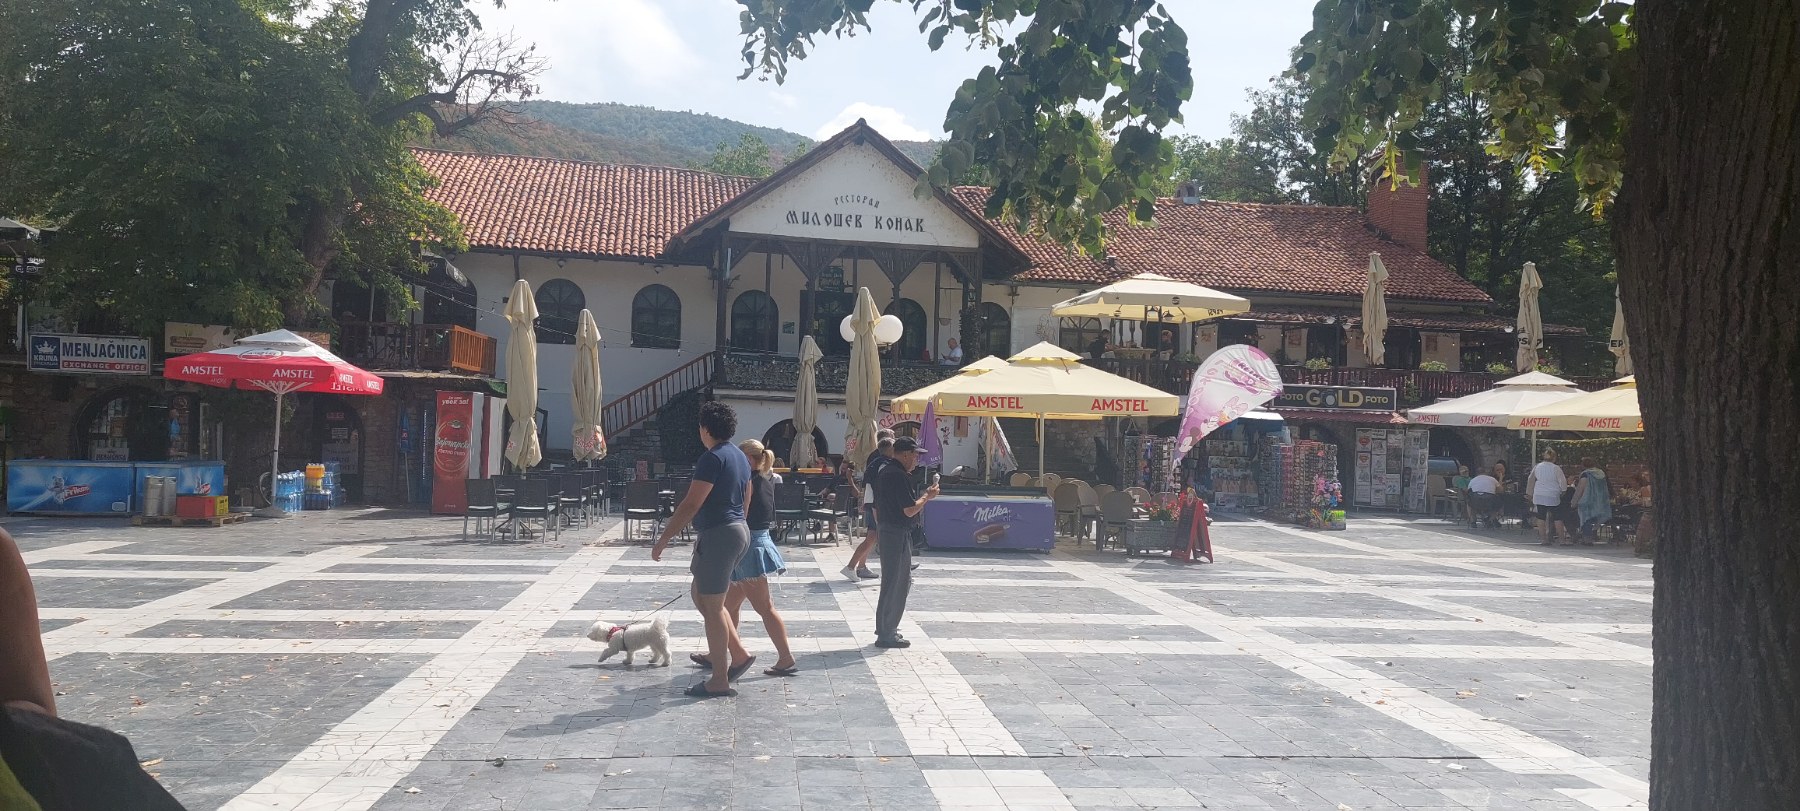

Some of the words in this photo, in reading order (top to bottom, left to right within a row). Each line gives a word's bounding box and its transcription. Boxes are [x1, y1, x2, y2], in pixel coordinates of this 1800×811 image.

[786, 210, 863, 228] МИЛОШЕВ
[874, 215, 925, 232] КОНАК
[62, 340, 147, 360] MENJAČNICA
[63, 361, 110, 369] EXCHANGE
[114, 363, 146, 371] OFFICE
[181, 365, 224, 375] AMSTEL
[273, 368, 314, 379] AMSTEL
[966, 395, 1024, 409] AMSTEL
[1365, 395, 1389, 404] FOTO
[1091, 399, 1149, 412] AMSTEL
[1468, 415, 1495, 425] AMSTEL
[1519, 417, 1551, 428] AMSTEL
[1587, 417, 1621, 429] AMSTEL
[973, 505, 1009, 522] Milka
